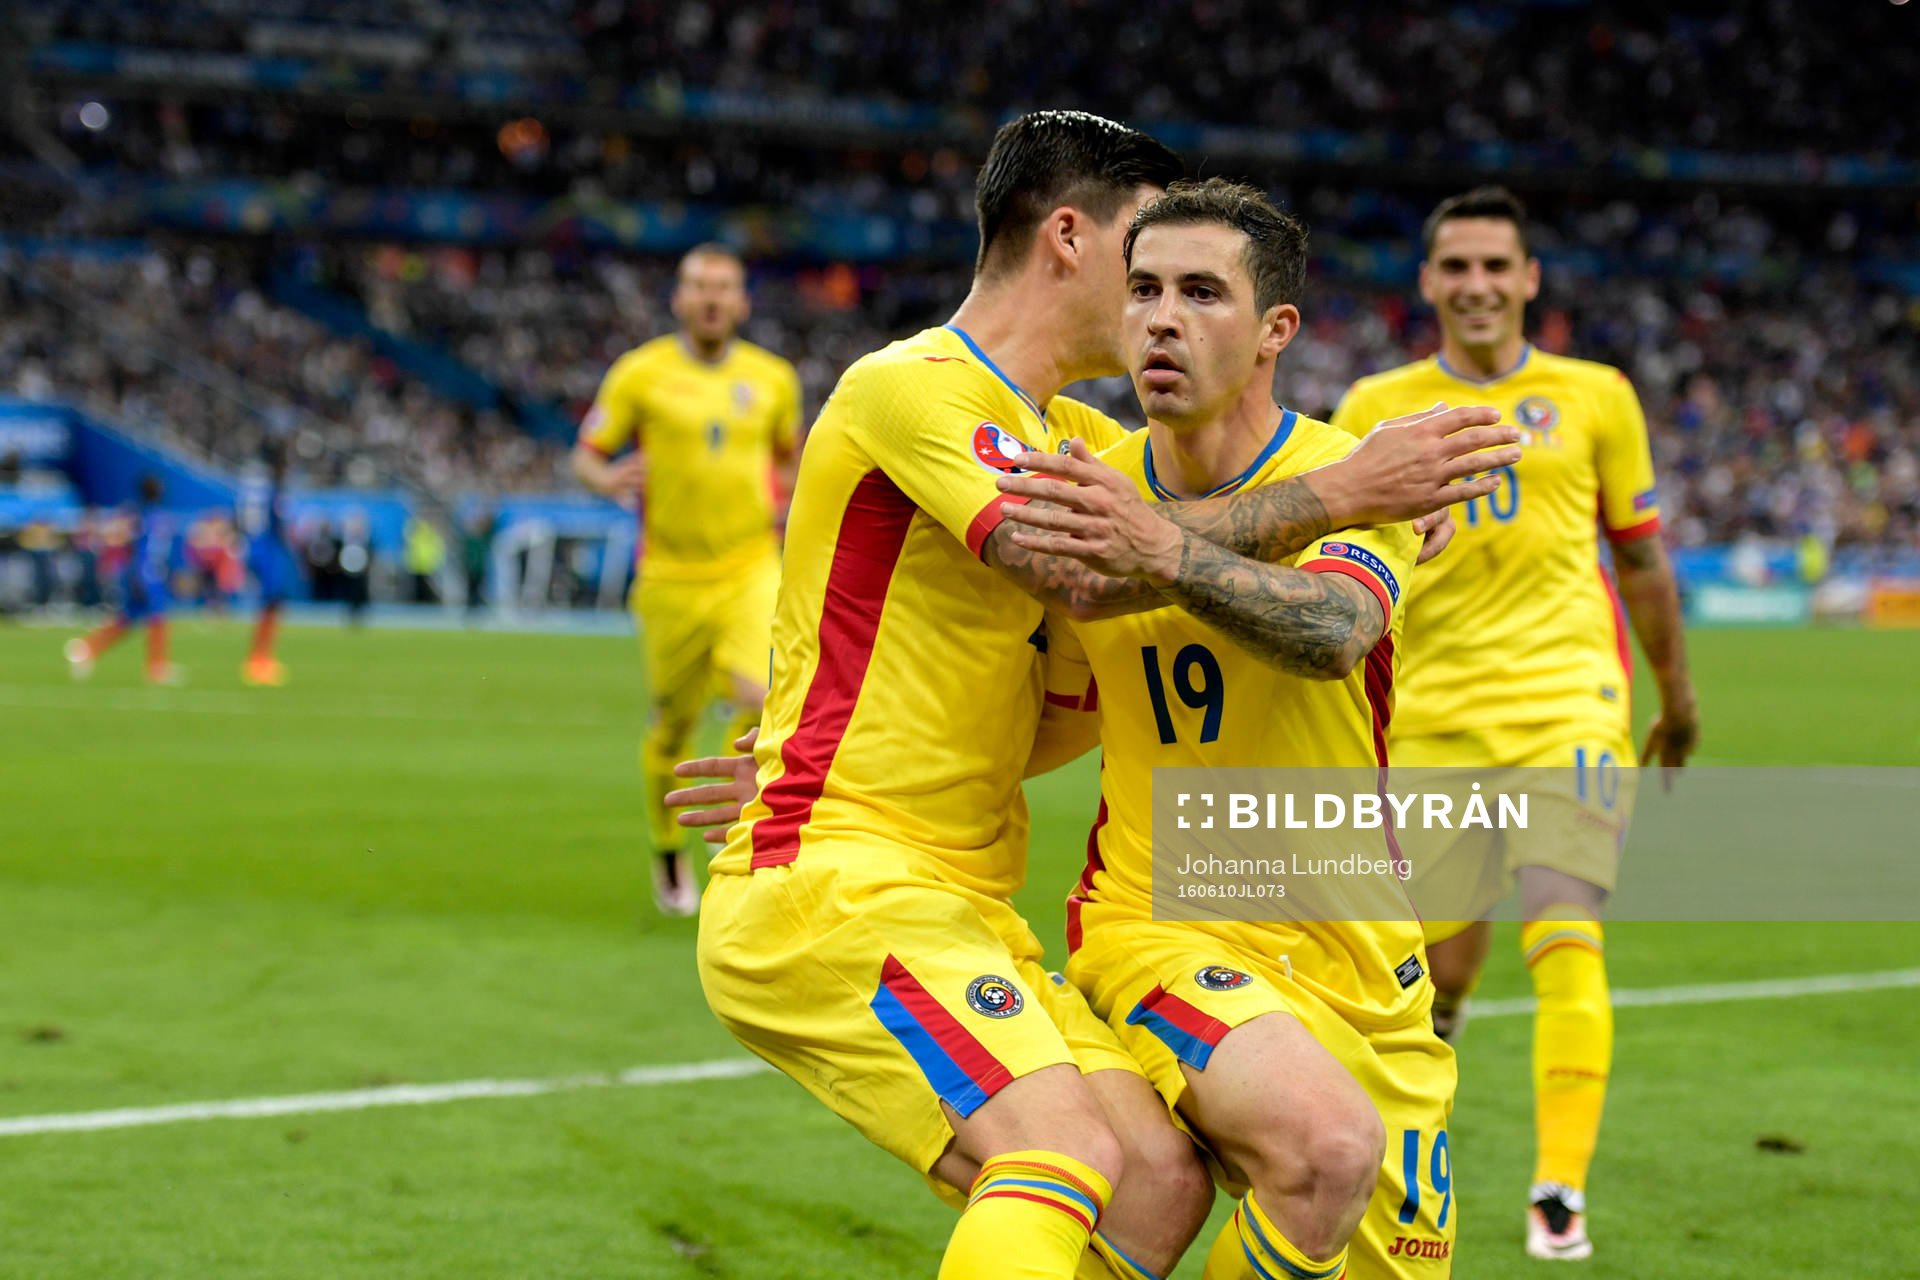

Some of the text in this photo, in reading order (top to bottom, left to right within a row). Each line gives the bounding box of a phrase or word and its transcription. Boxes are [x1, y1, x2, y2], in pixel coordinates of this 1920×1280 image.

[1141, 643, 1224, 744] 19
[1575, 747, 1621, 811] 10
[1398, 1129, 1451, 1229] 19
